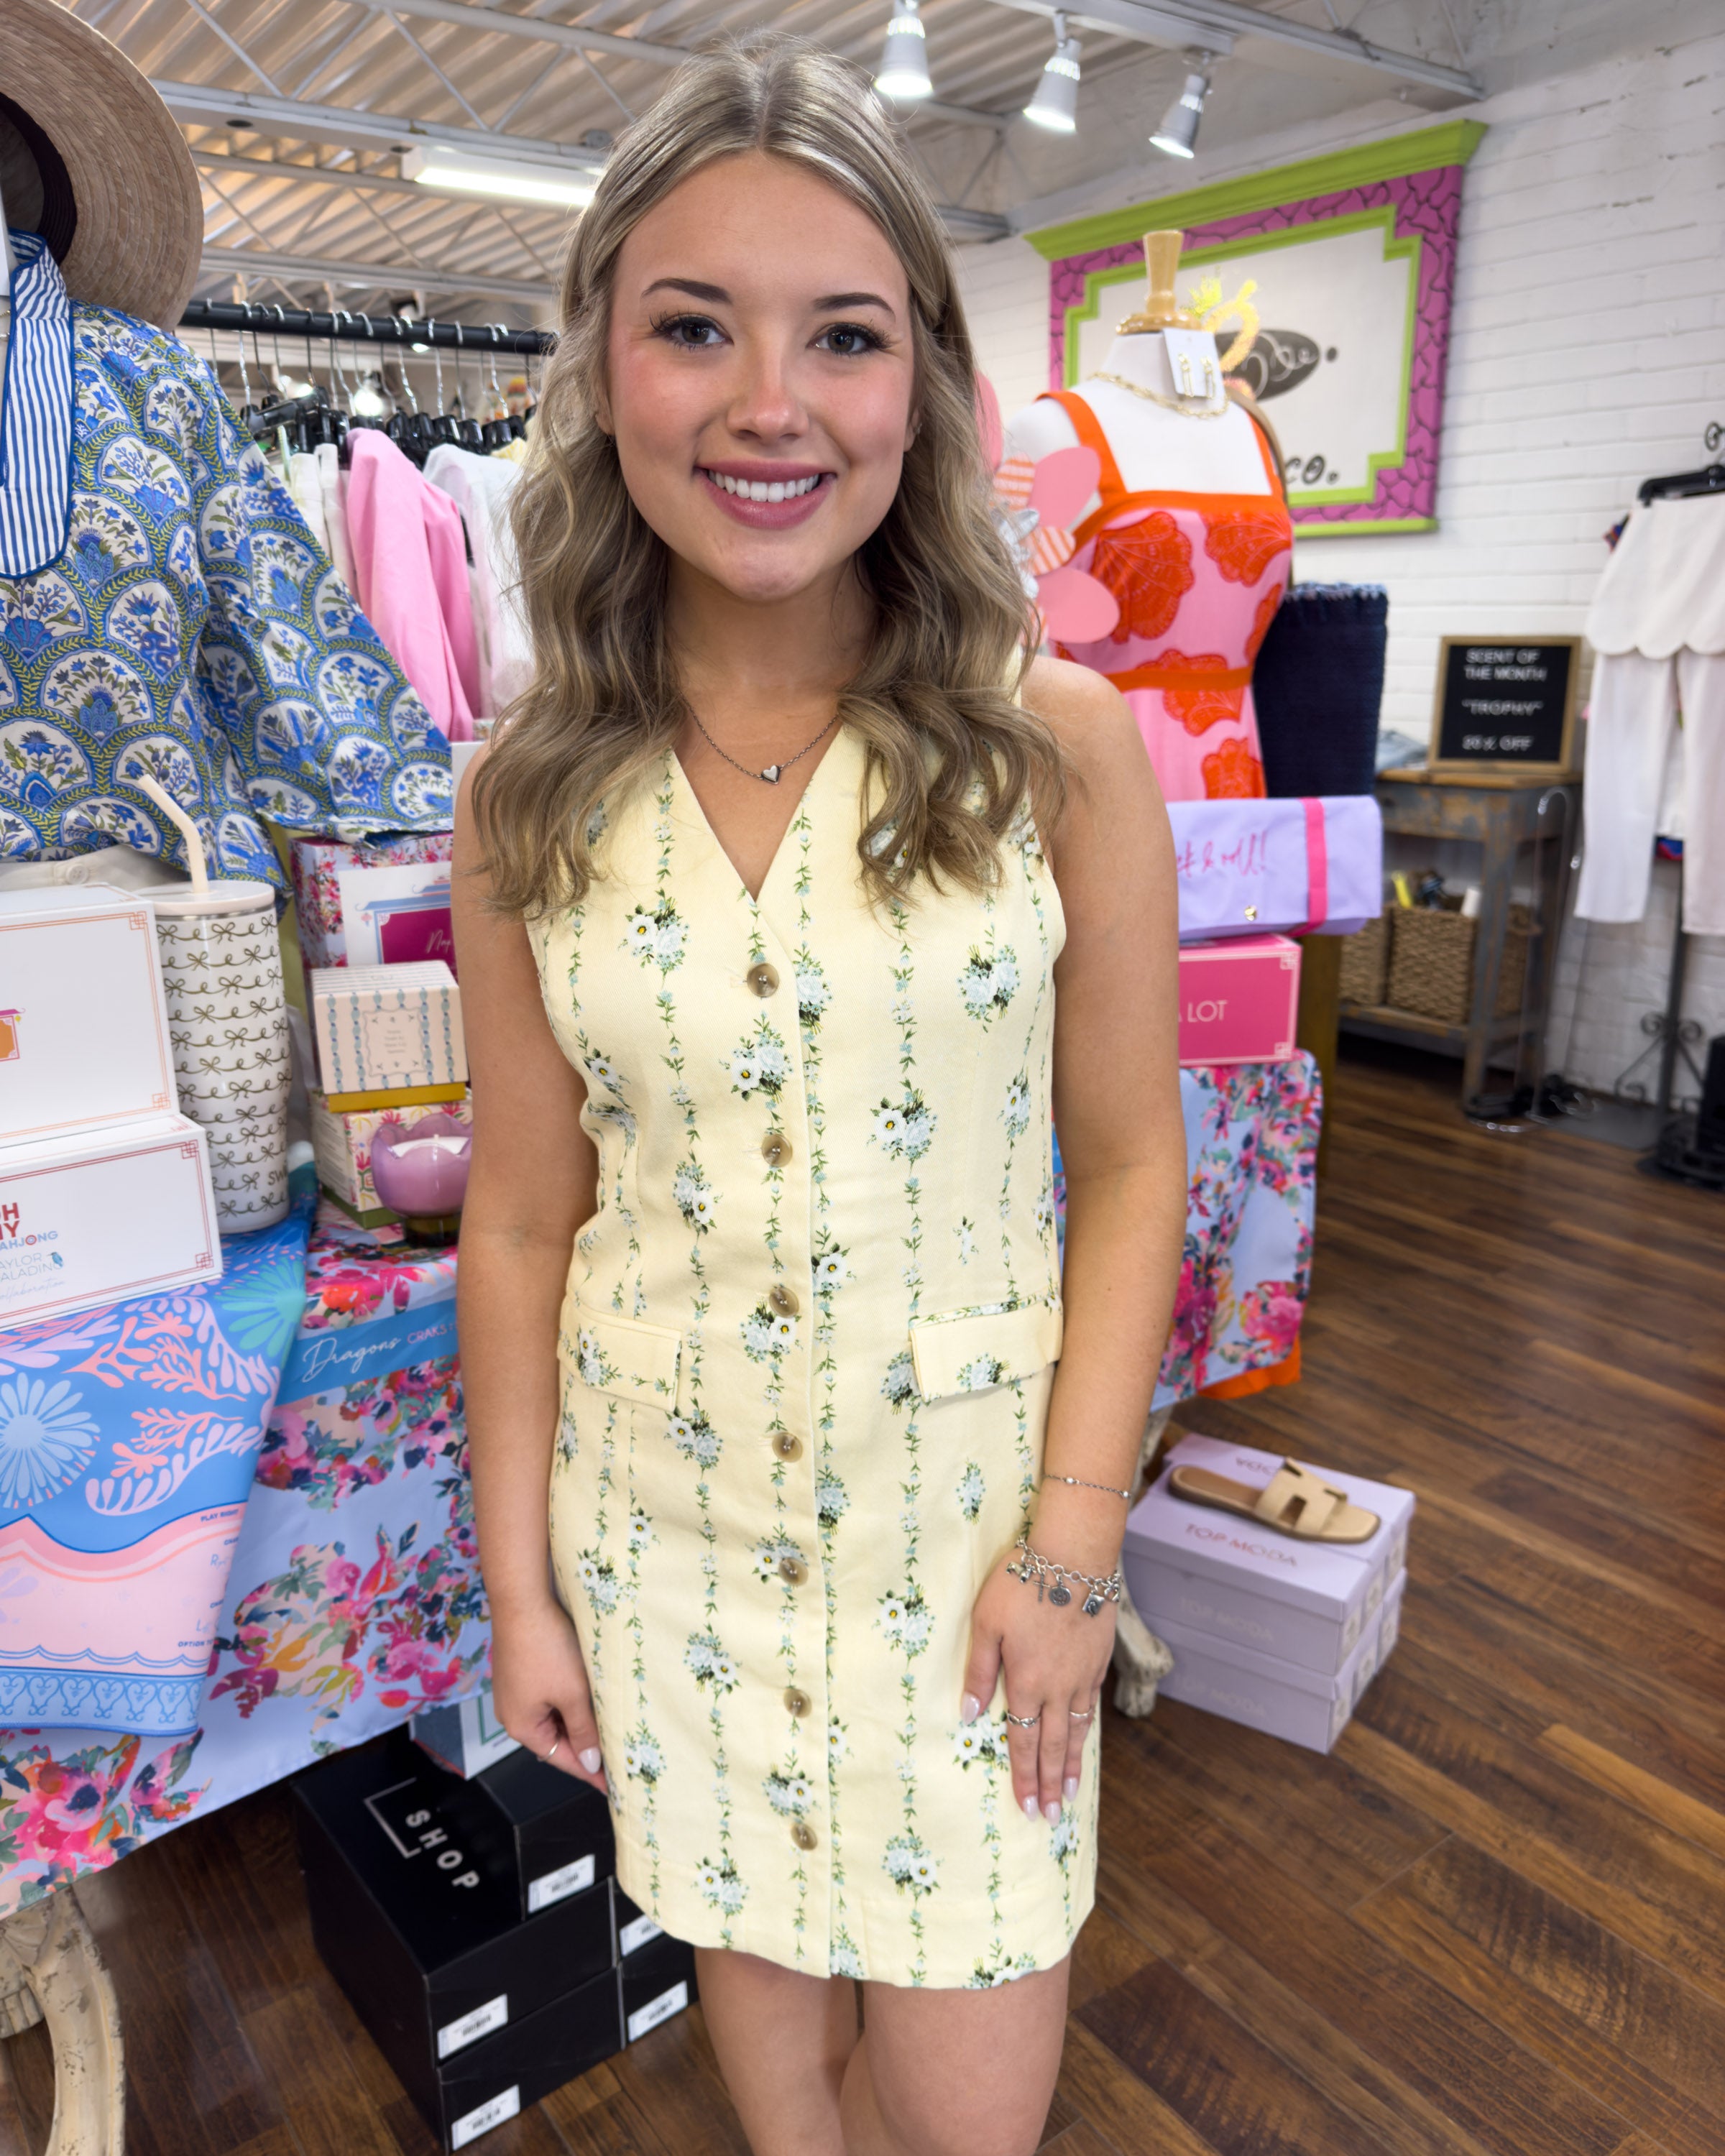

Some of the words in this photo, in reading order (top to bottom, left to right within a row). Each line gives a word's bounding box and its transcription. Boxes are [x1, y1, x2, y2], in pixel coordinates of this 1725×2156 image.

[1466, 648, 1515, 664] SCENT
[1517, 648, 1540, 664] OF
[1464, 665, 1493, 681] THE
[1494, 665, 1547, 681] MONTH
[1499, 734, 1535, 751] OFF
[1187, 1000, 1228, 1022] LOT
[0, 1202, 19, 1221] H
[0, 1220, 20, 1240] Y
[0, 1230, 58, 1250] AHJONG
[0, 1253, 42, 1270] AYLOR
[0, 1261, 63, 1282] ALADINO
[0, 1277, 66, 1304] ollaboration
[302, 1337, 401, 1383] Dragons
[407, 1324, 447, 1344] CRAKS
[201, 1512, 218, 1522] PLAY
[1186, 1523, 1227, 1542] TOP
[1230, 1538, 1297, 1567] MODA
[405, 1810, 479, 1888] SHOP
